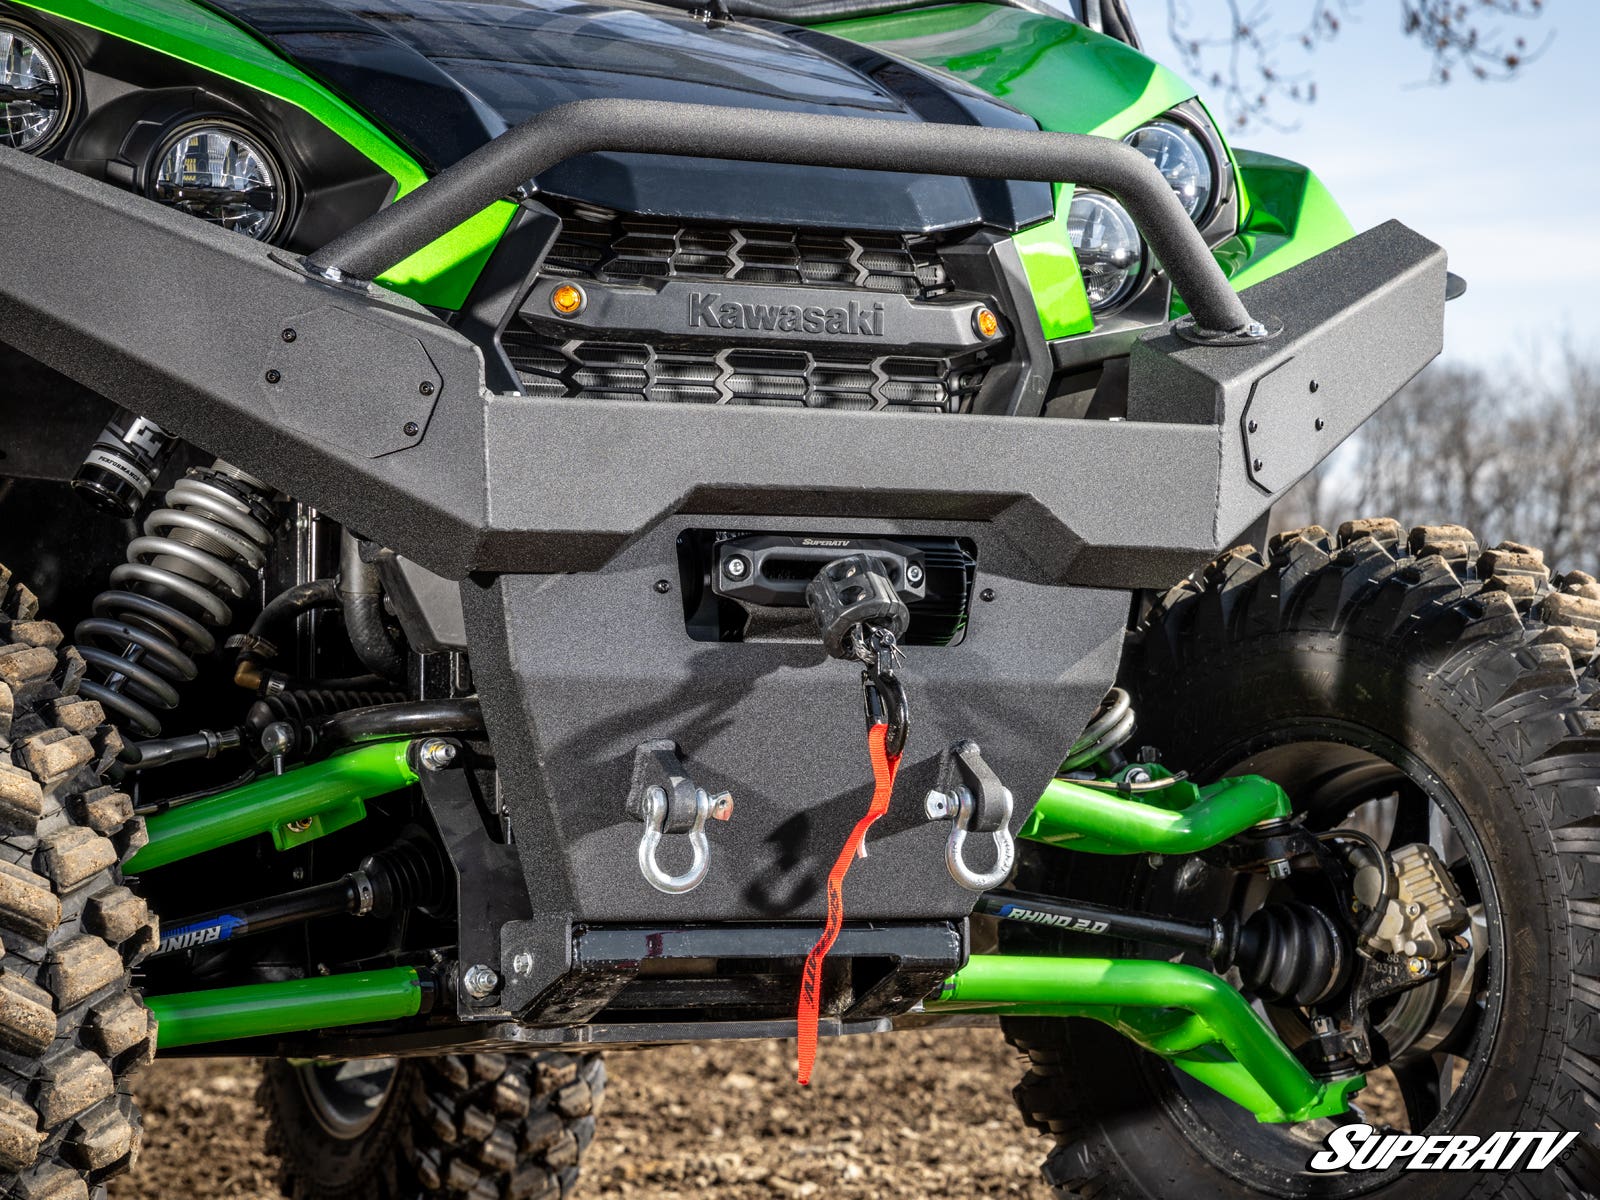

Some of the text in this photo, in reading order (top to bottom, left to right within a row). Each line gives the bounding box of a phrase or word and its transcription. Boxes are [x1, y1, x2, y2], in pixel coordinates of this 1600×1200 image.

[689, 292, 885, 337] Kawasaki
[802, 538, 850, 547] SUPERATV
[1007, 908, 1109, 934] RHINO 2.0
